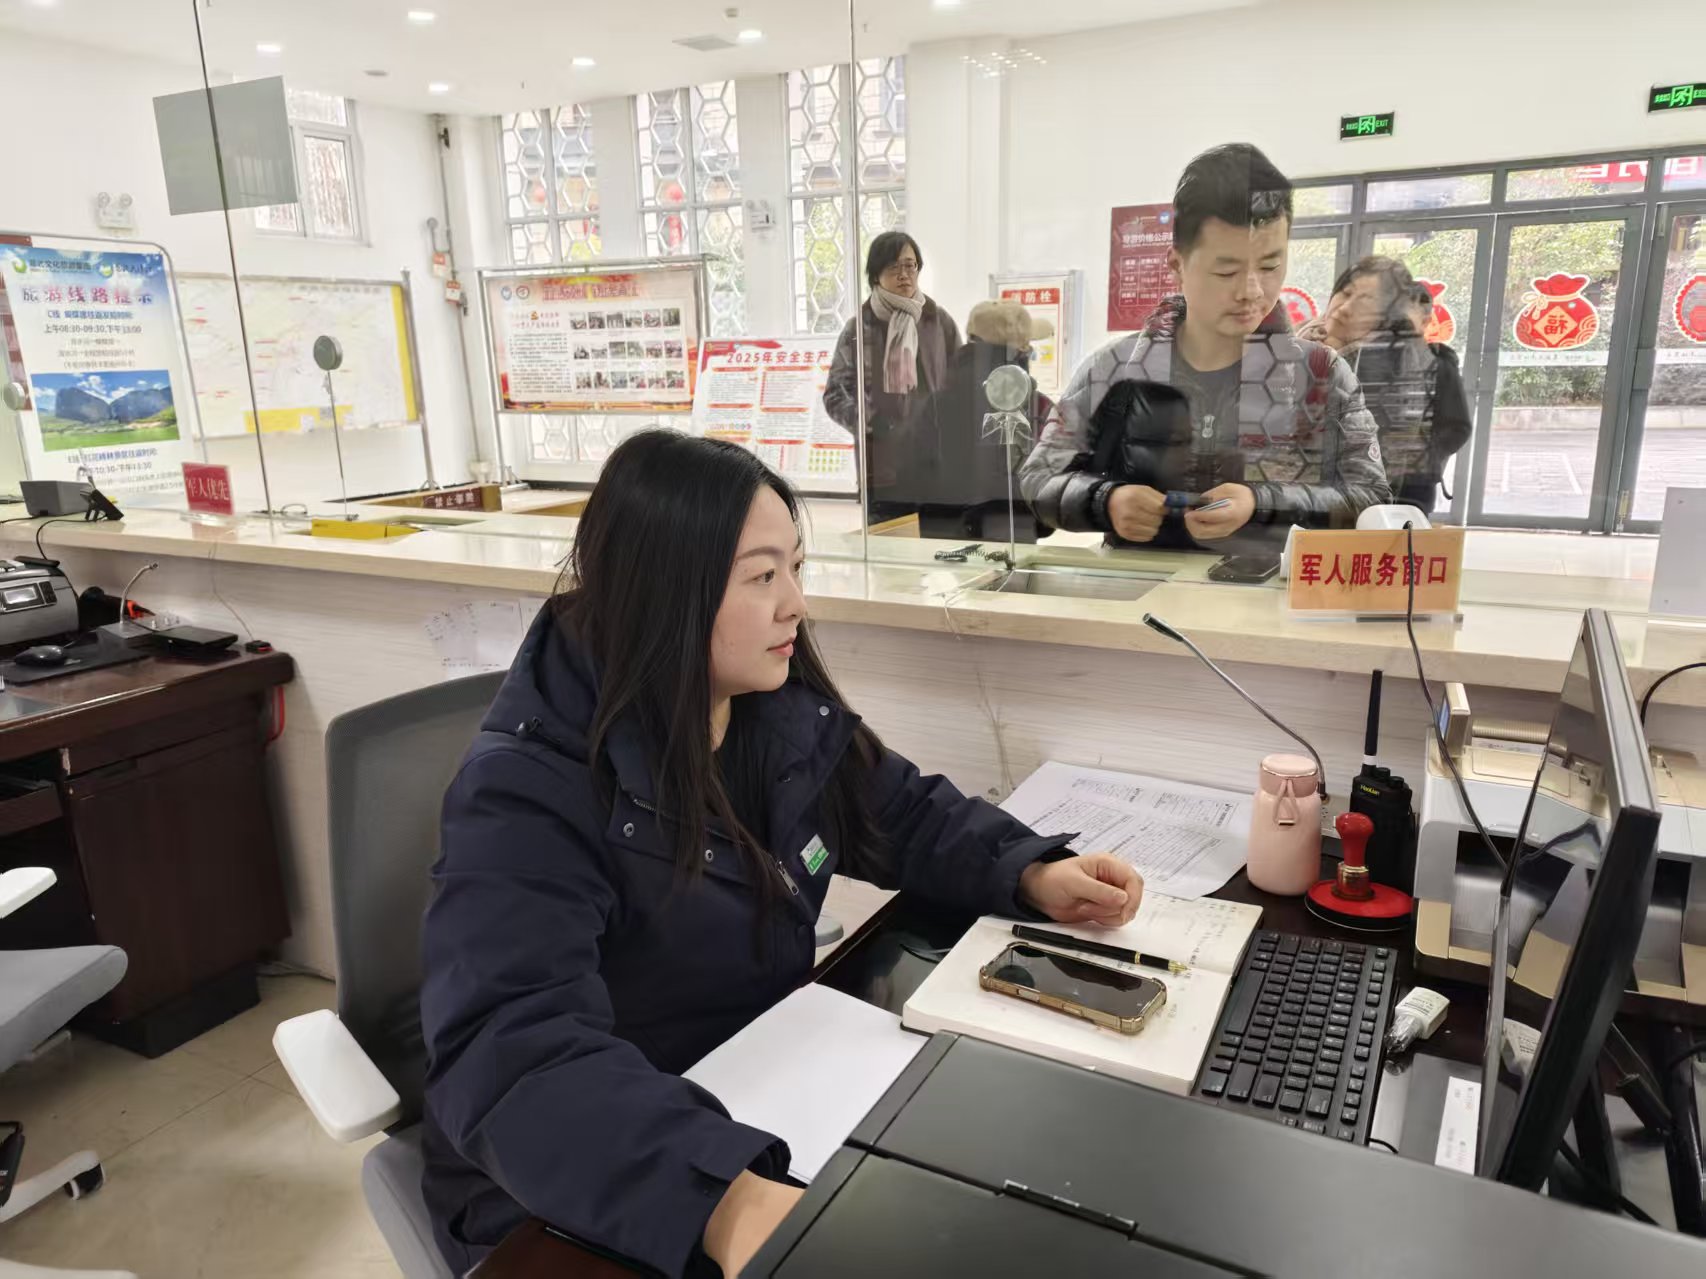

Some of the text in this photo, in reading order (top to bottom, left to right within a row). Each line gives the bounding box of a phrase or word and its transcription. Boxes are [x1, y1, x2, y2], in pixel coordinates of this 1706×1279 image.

[22, 285, 153, 305] 旅游线路提示
[1299, 552, 1448, 587] 军人服务窗口
